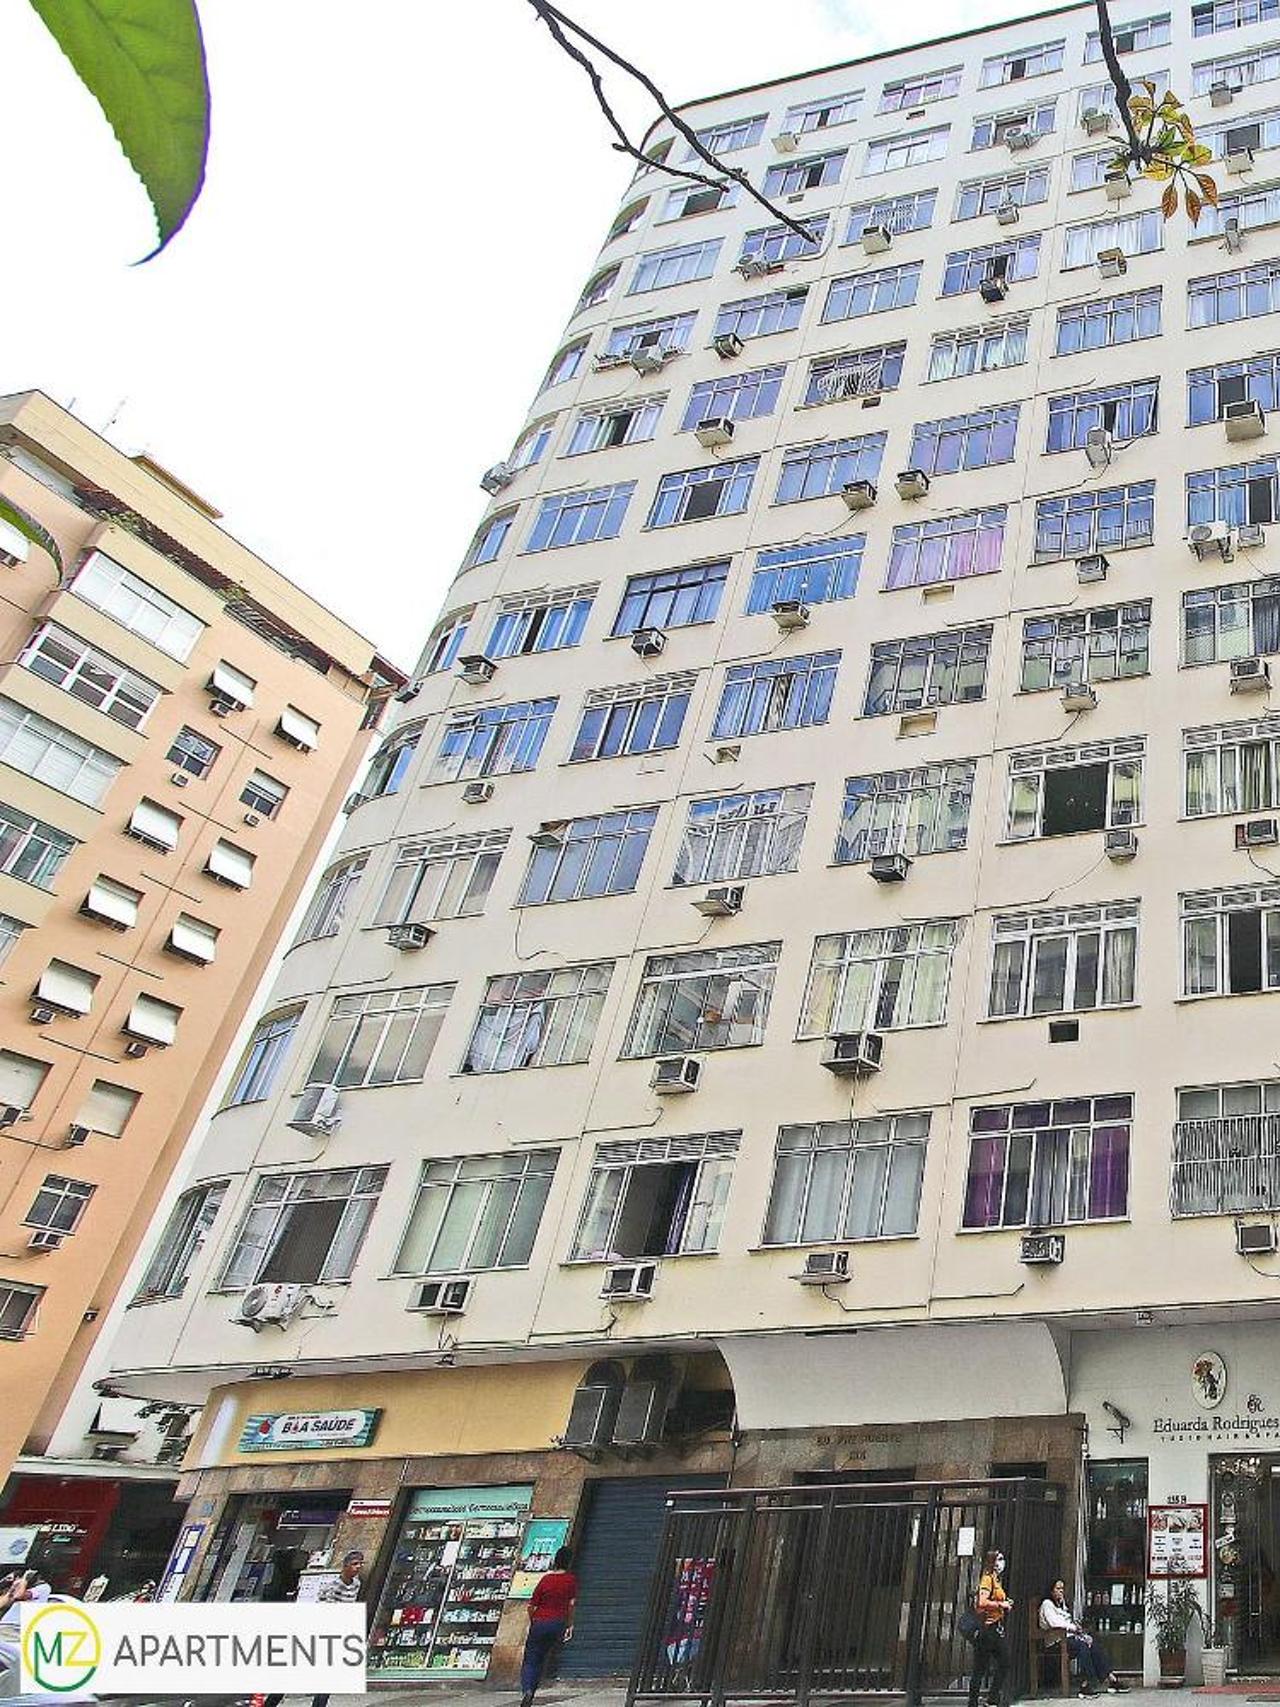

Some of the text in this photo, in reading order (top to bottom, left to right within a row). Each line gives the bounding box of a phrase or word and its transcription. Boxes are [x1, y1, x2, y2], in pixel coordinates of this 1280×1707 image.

[310, 1416, 356, 1432] SAÚDE
[1153, 1415, 1280, 1434] Eduarda Rodrigues
